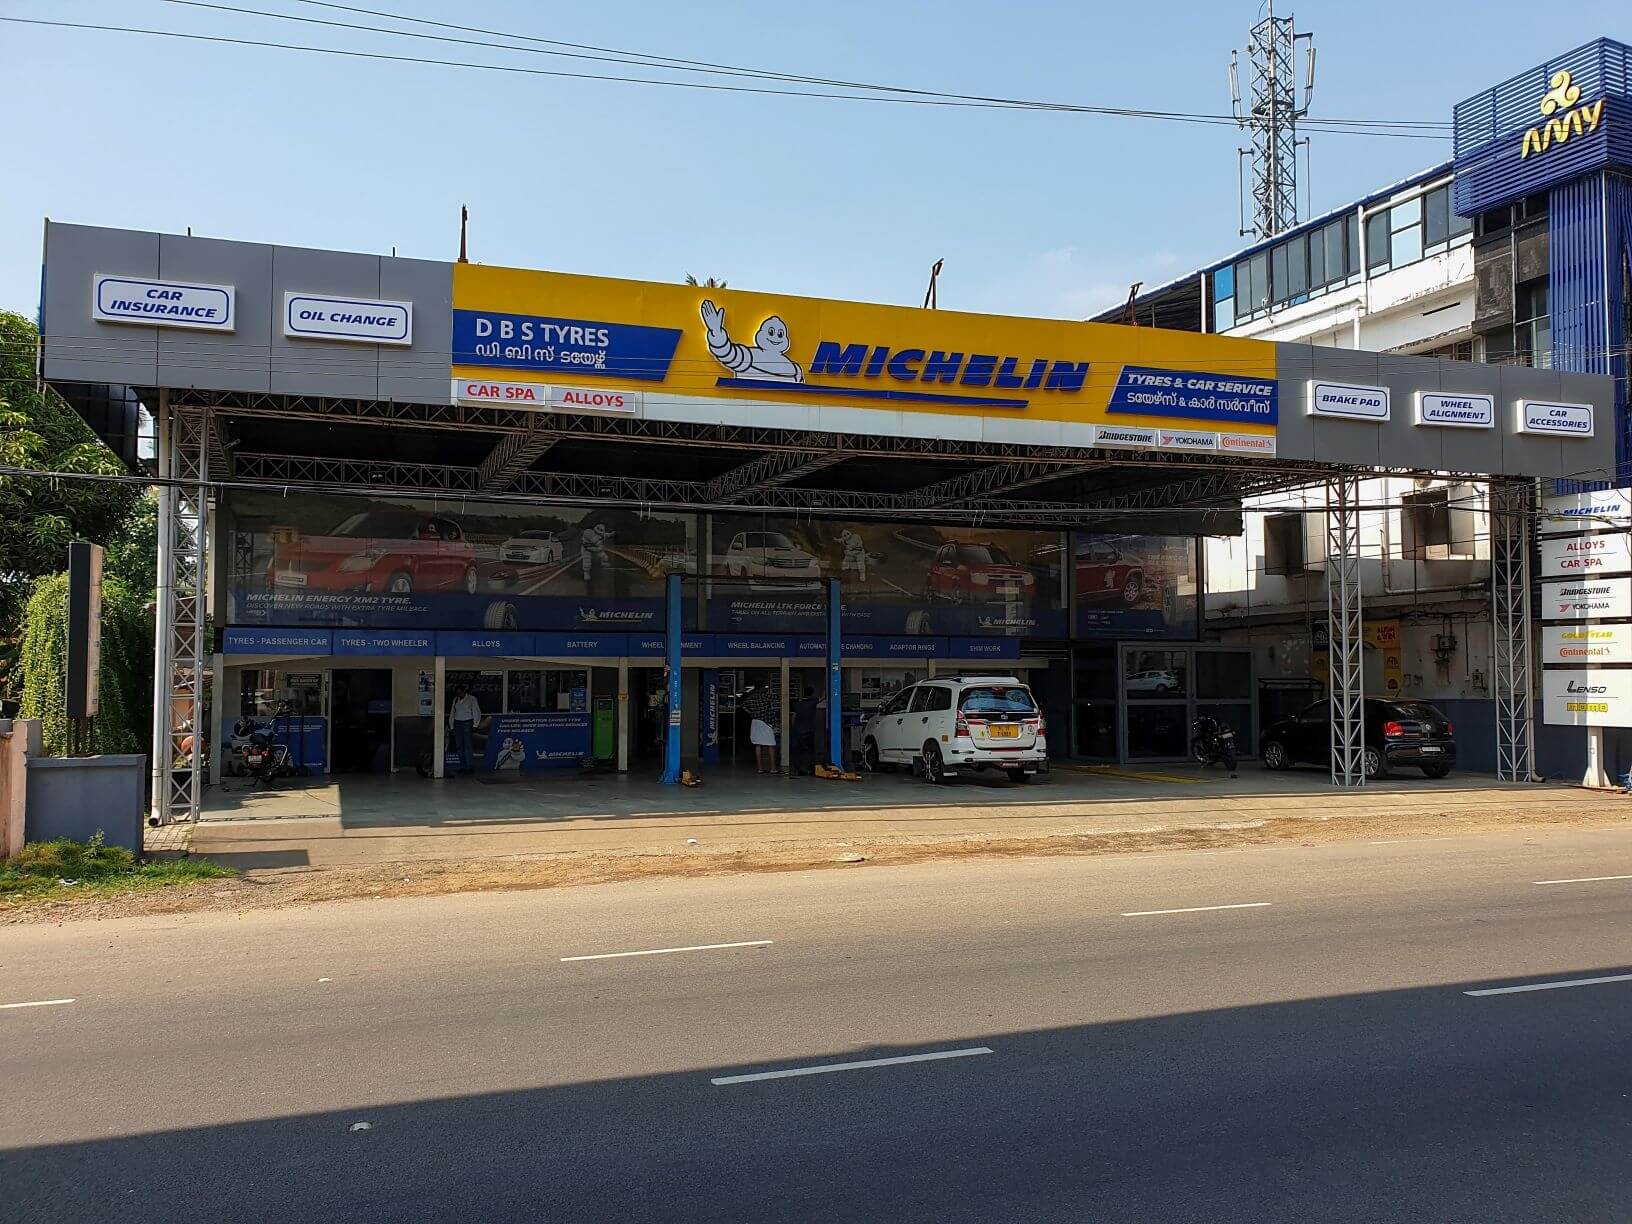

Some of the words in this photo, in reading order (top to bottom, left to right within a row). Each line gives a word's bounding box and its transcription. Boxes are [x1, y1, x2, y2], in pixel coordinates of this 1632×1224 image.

[146, 289, 183, 301] CAR
[110, 300, 217, 319] INSURANCE
[299, 310, 328, 321] OIL
[329, 312, 397, 327] CHANGE
[476, 318, 493, 337] D
[500, 320, 514, 339] B
[521, 322, 534, 342] S
[540, 323, 609, 348] TYRES
[808, 341, 1091, 392] MICHELIN
[1128, 374, 1172, 388] TYRES
[1172, 378, 1184, 389] &
[1187, 379, 1215, 392] CAR
[1216, 382, 1273, 396] SERVICE
[467, 384, 501, 398] CAR
[505, 387, 536, 401] SPA
[563, 391, 625, 408] ALLOYS
[1179, 397, 1188, 408] &
[1322, 394, 1358, 406] BRAKE
[1359, 397, 1381, 408] PAD
[1440, 399, 1473, 410] WHEEL
[1429, 409, 1486, 420] ALIGNMENT
[1549, 409, 1568, 418] CAR
[1529, 417, 1588, 430] ACCESSORIES
[1098, 430, 1153, 443] BRIDGESTONE
[1174, 436, 1214, 447] YOKOHAMA
[1222, 436, 1266, 449] Continental
[1563, 504, 1621, 516] MICHELIN
[1566, 540, 1606, 551] ALLOYS
[1560, 559, 1580, 569] CAR
[1584, 558, 1603, 568] SPA
[1560, 586, 1612, 597] BRIDGESTONE
[246, 593, 304, 602] MICHELIN
[305, 595, 352, 603] ENERGY
[353, 596, 379, 605] XM2
[381, 597, 412, 605] TYRE.
[730, 601, 776, 610] MICHELIN
[1572, 602, 1610, 611] YOKOHAMA
[598, 611, 654, 619] MICHELIN
[229, 637, 255, 645] TYRES
[261, 637, 309, 646] PASSENGER
[311, 638, 328, 646] CAR
[342, 639, 366, 647] TYRES
[372, 639, 390, 647] TWO
[391, 639, 428, 647] WHEELER
[472, 640, 500, 648] ALLOYS
[641, 641, 665, 649] WHEEL
[1566, 680, 1608, 694] LENSO
